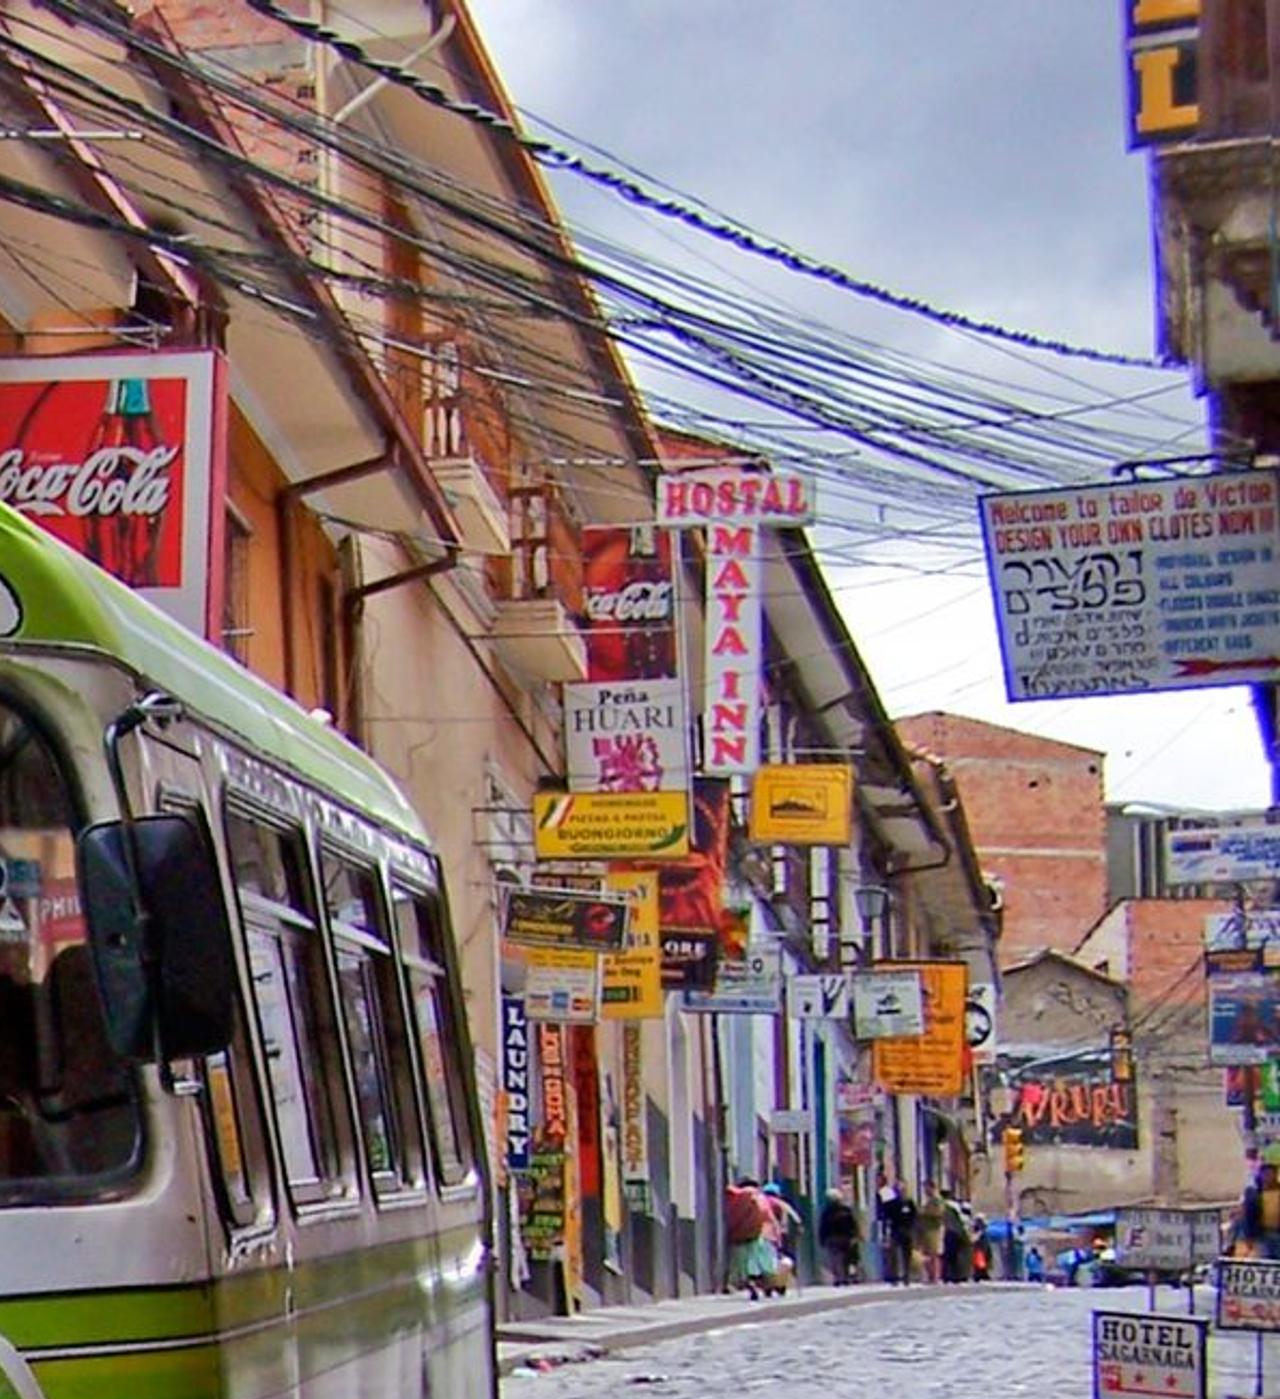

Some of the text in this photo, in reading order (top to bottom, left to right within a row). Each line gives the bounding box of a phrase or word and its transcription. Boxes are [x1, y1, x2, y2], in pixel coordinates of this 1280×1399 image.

[665, 479, 808, 518] HOSTAL
[1076, 496, 1100, 519] to
[995, 527, 1053, 555] DESIGN
[1057, 524, 1102, 549] YOUR
[713, 526, 752, 766] MAYA INN
[598, 687, 650, 706] Peña
[573, 704, 674, 733] HUARI
[506, 1005, 528, 1156] LAUNDRY
[1101, 1319, 1193, 1349] HOTEL
